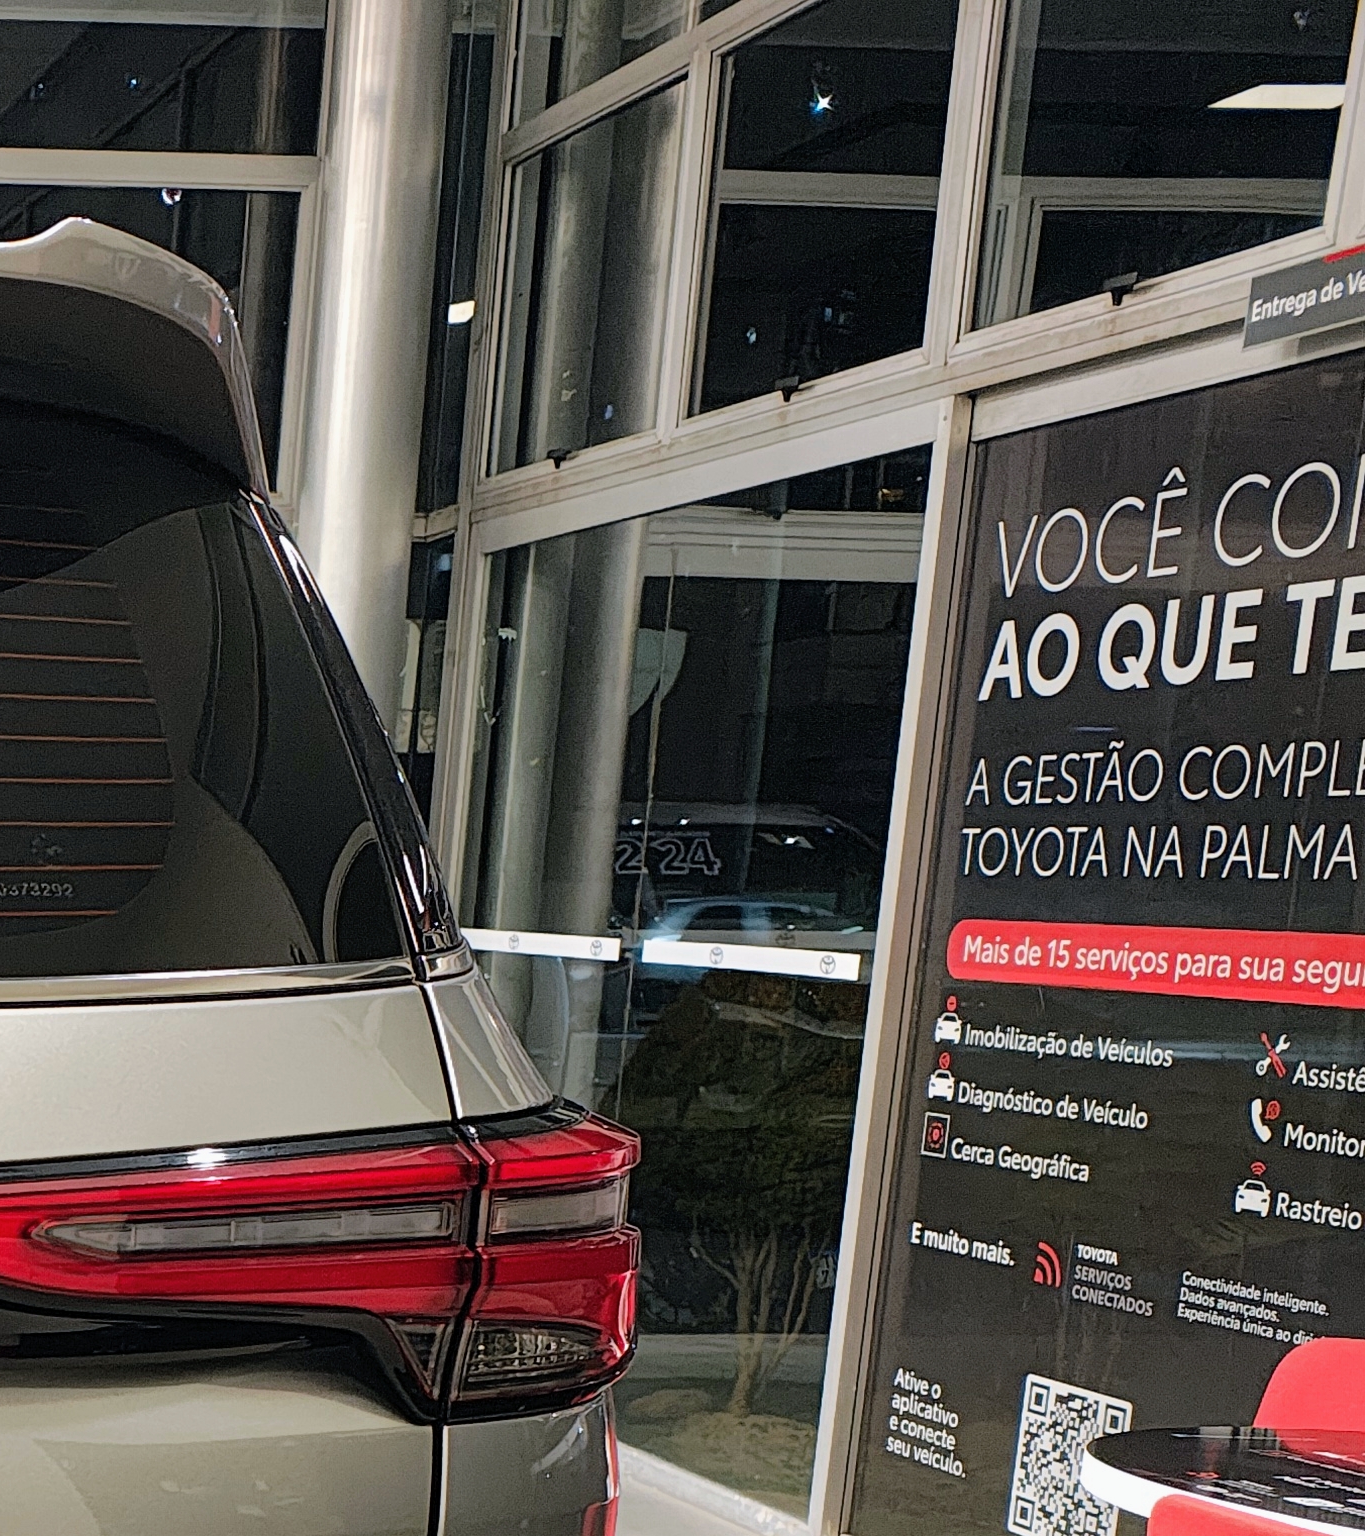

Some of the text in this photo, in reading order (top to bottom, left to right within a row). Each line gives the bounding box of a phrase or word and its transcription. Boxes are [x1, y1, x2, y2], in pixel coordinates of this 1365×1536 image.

[1251, 289, 1317, 322] Entrega
[1320, 277, 1344, 303] de
[998, 454, 1365, 597] VOCÊ CO
[978, 612, 1080, 701] AO
[1098, 589, 1263, 690] QUE
[965, 758, 990, 806] A
[1004, 740, 1164, 806] GESTÃO
[962, 823, 1358, 881] TOYOTA NA PALMA
[963, 935, 1365, 994] Mais de 15 serviços para sua segu
[965, 1023, 1174, 1068] Imobilização de Veículos
[958, 1081, 1148, 1129] Diagnóstico de Veículo
[950, 1138, 1089, 1182] Cerca Geográfica
[1275, 1192, 1363, 1230] Rastreio
[910, 1222, 1015, 1266] E muito mais.
[1077, 1244, 1118, 1266] TOYOTA
[1074, 1264, 1132, 1291] SERVIÇOS
[1182, 1270, 1330, 1316] Conectividade inteligente.
[1072, 1285, 1154, 1316] CONECTADOS
[1179, 1287, 1280, 1322] Dados avançados.
[1177, 1303, 1240, 1330] Experiência
[1242, 1319, 1274, 1339] única
[1275, 1328, 1291, 1343] ao
[894, 1368, 942, 1399] Ative o
[889, 1415, 956, 1450] e conecte
[891, 1393, 959, 1428] aplicativo
[886, 1436, 966, 1478] seu veículo.
